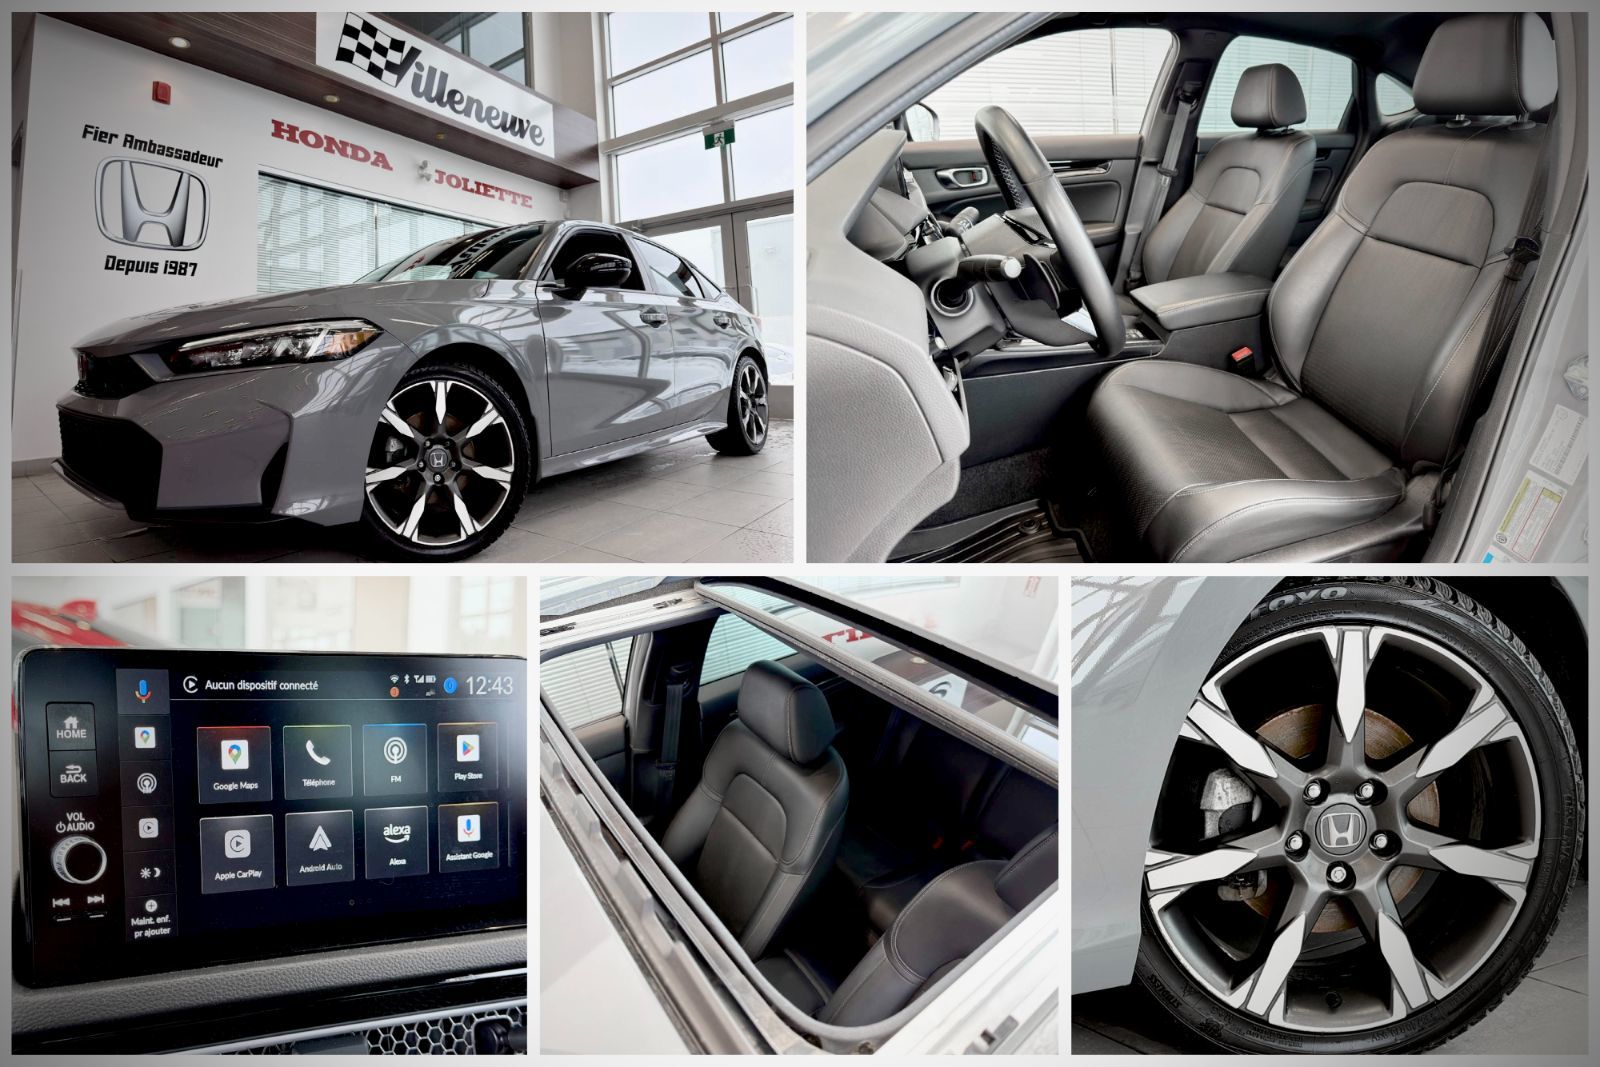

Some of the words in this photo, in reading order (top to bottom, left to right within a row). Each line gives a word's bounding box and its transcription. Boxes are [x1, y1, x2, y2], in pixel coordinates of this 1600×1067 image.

[383, 46, 545, 146] Villeneuve
[82, 124, 119, 144] Fier
[122, 133, 223, 168] Ambassadeur
[271, 119, 393, 171] HONDA
[435, 169, 533, 208] JOLIETTE
[104, 255, 159, 275] Depuis
[205, 680, 234, 691] Aucun
[237, 679, 278, 692] dispositif
[279, 680, 319, 690] connecté
[466, 676, 514, 695] 12:43
[56, 729, 87, 739] HOME
[60, 773, 87, 784] BACK
[390, 776, 402, 784] FM
[454, 772, 467, 781] Play
[468, 771, 483, 780] Store
[213, 781, 238, 791] Google
[239, 780, 259, 791] Maps
[302, 778, 336, 788] Téléphone
[66, 812, 85, 822] VOL
[66, 822, 95, 832] AUDIO
[383, 823, 412, 837] alexa
[389, 858, 407, 866] Alexa
[445, 854, 473, 862] Assistant
[473, 851, 493, 860] Google
[299, 864, 325, 874] Android
[326, 863, 343, 872] Auto
[215, 872, 236, 882] Apple
[236, 869, 263, 880] CarPlay
[131, 917, 155, 926] Maint.
[156, 916, 171, 924] enf.
[134, 929, 143, 939] pr
[144, 927, 171, 937] ajouter
